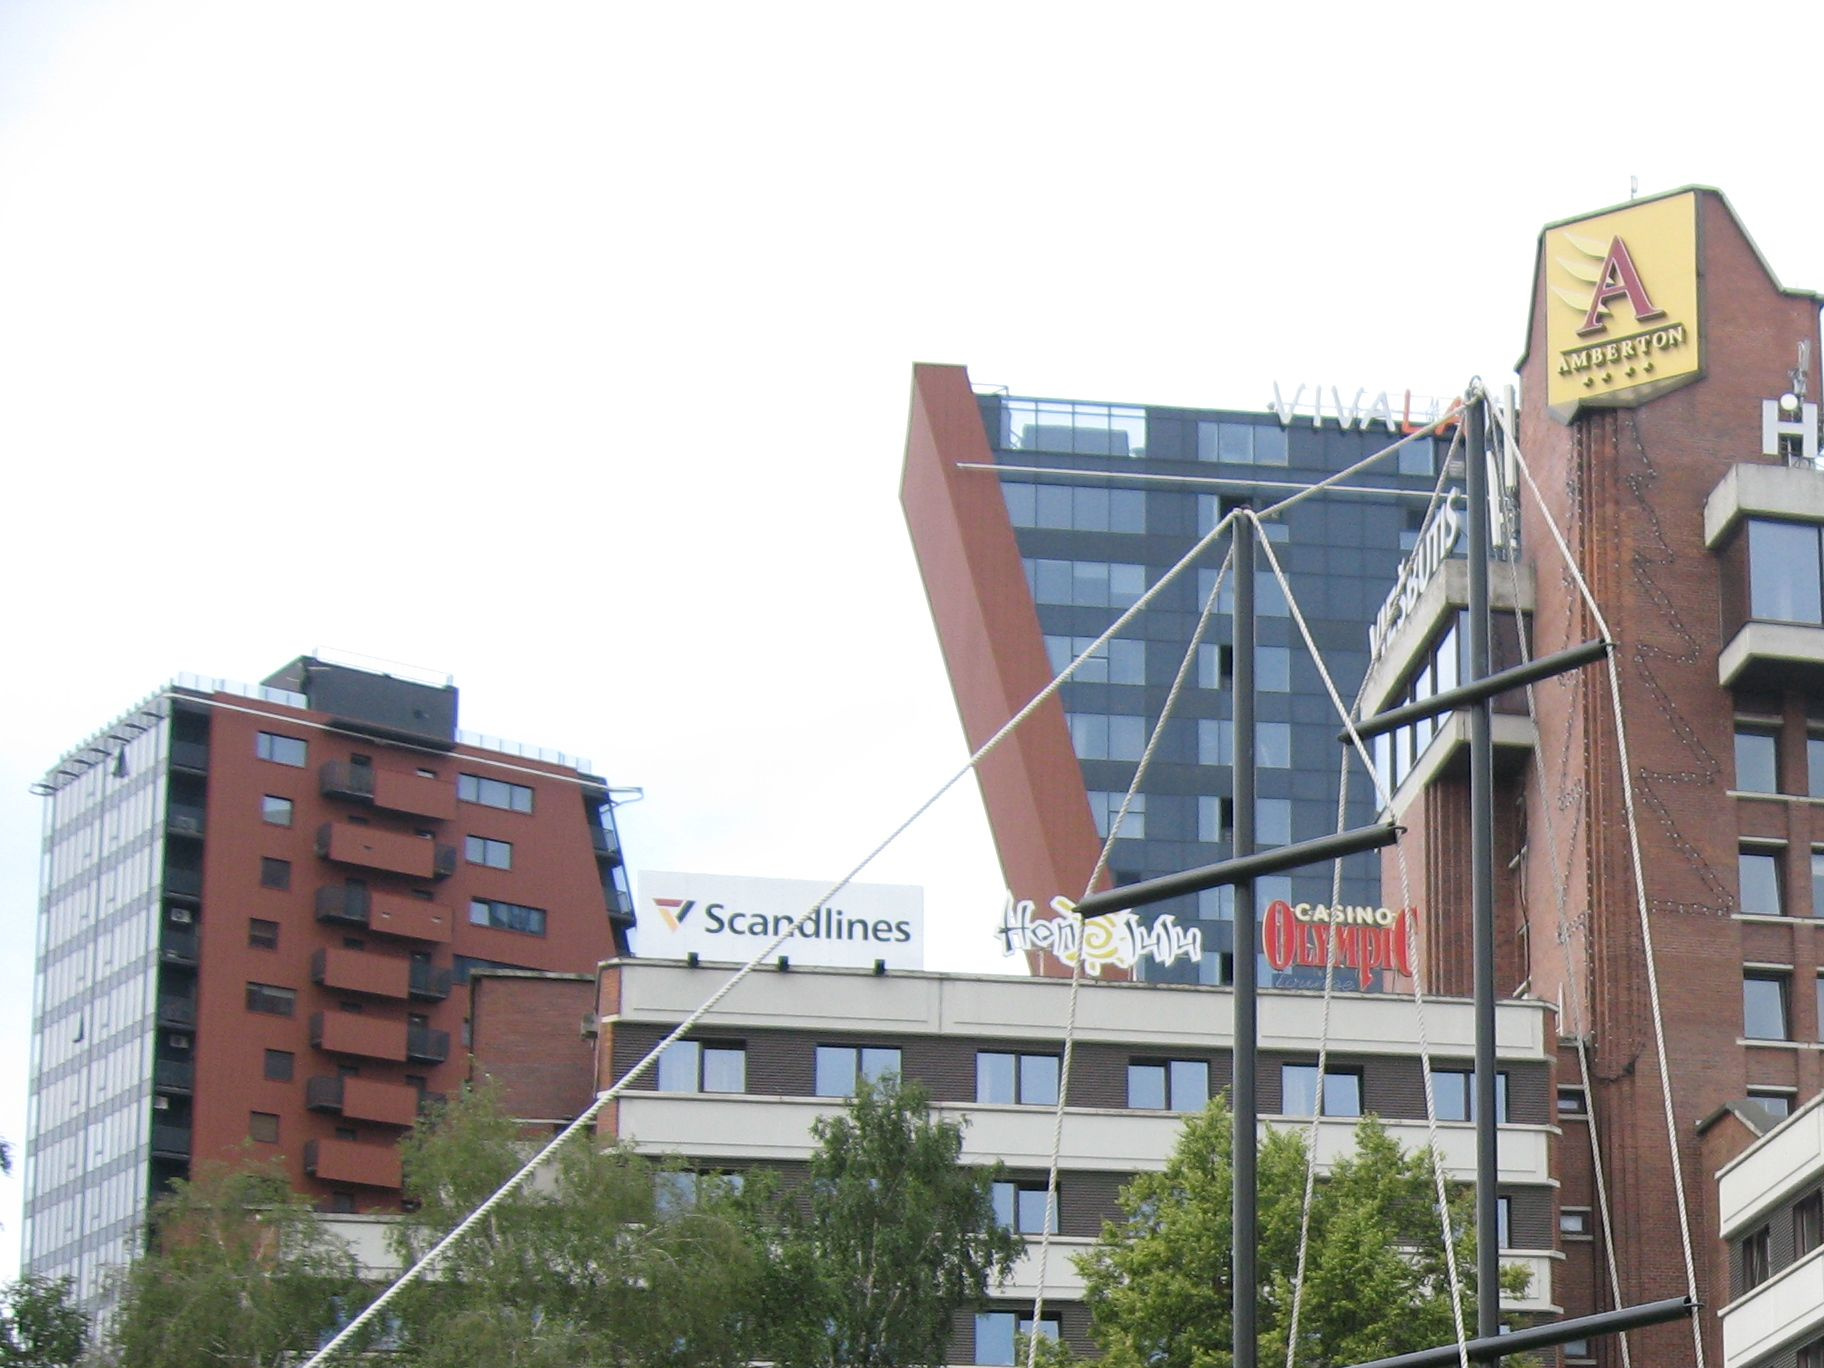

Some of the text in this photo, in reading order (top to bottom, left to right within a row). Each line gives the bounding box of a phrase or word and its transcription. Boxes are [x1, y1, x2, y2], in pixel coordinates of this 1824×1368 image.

[1558, 325, 1686, 376] AMBERTON
[704, 903, 912, 943] Scandlines
[1295, 903, 1394, 925] CASINO
